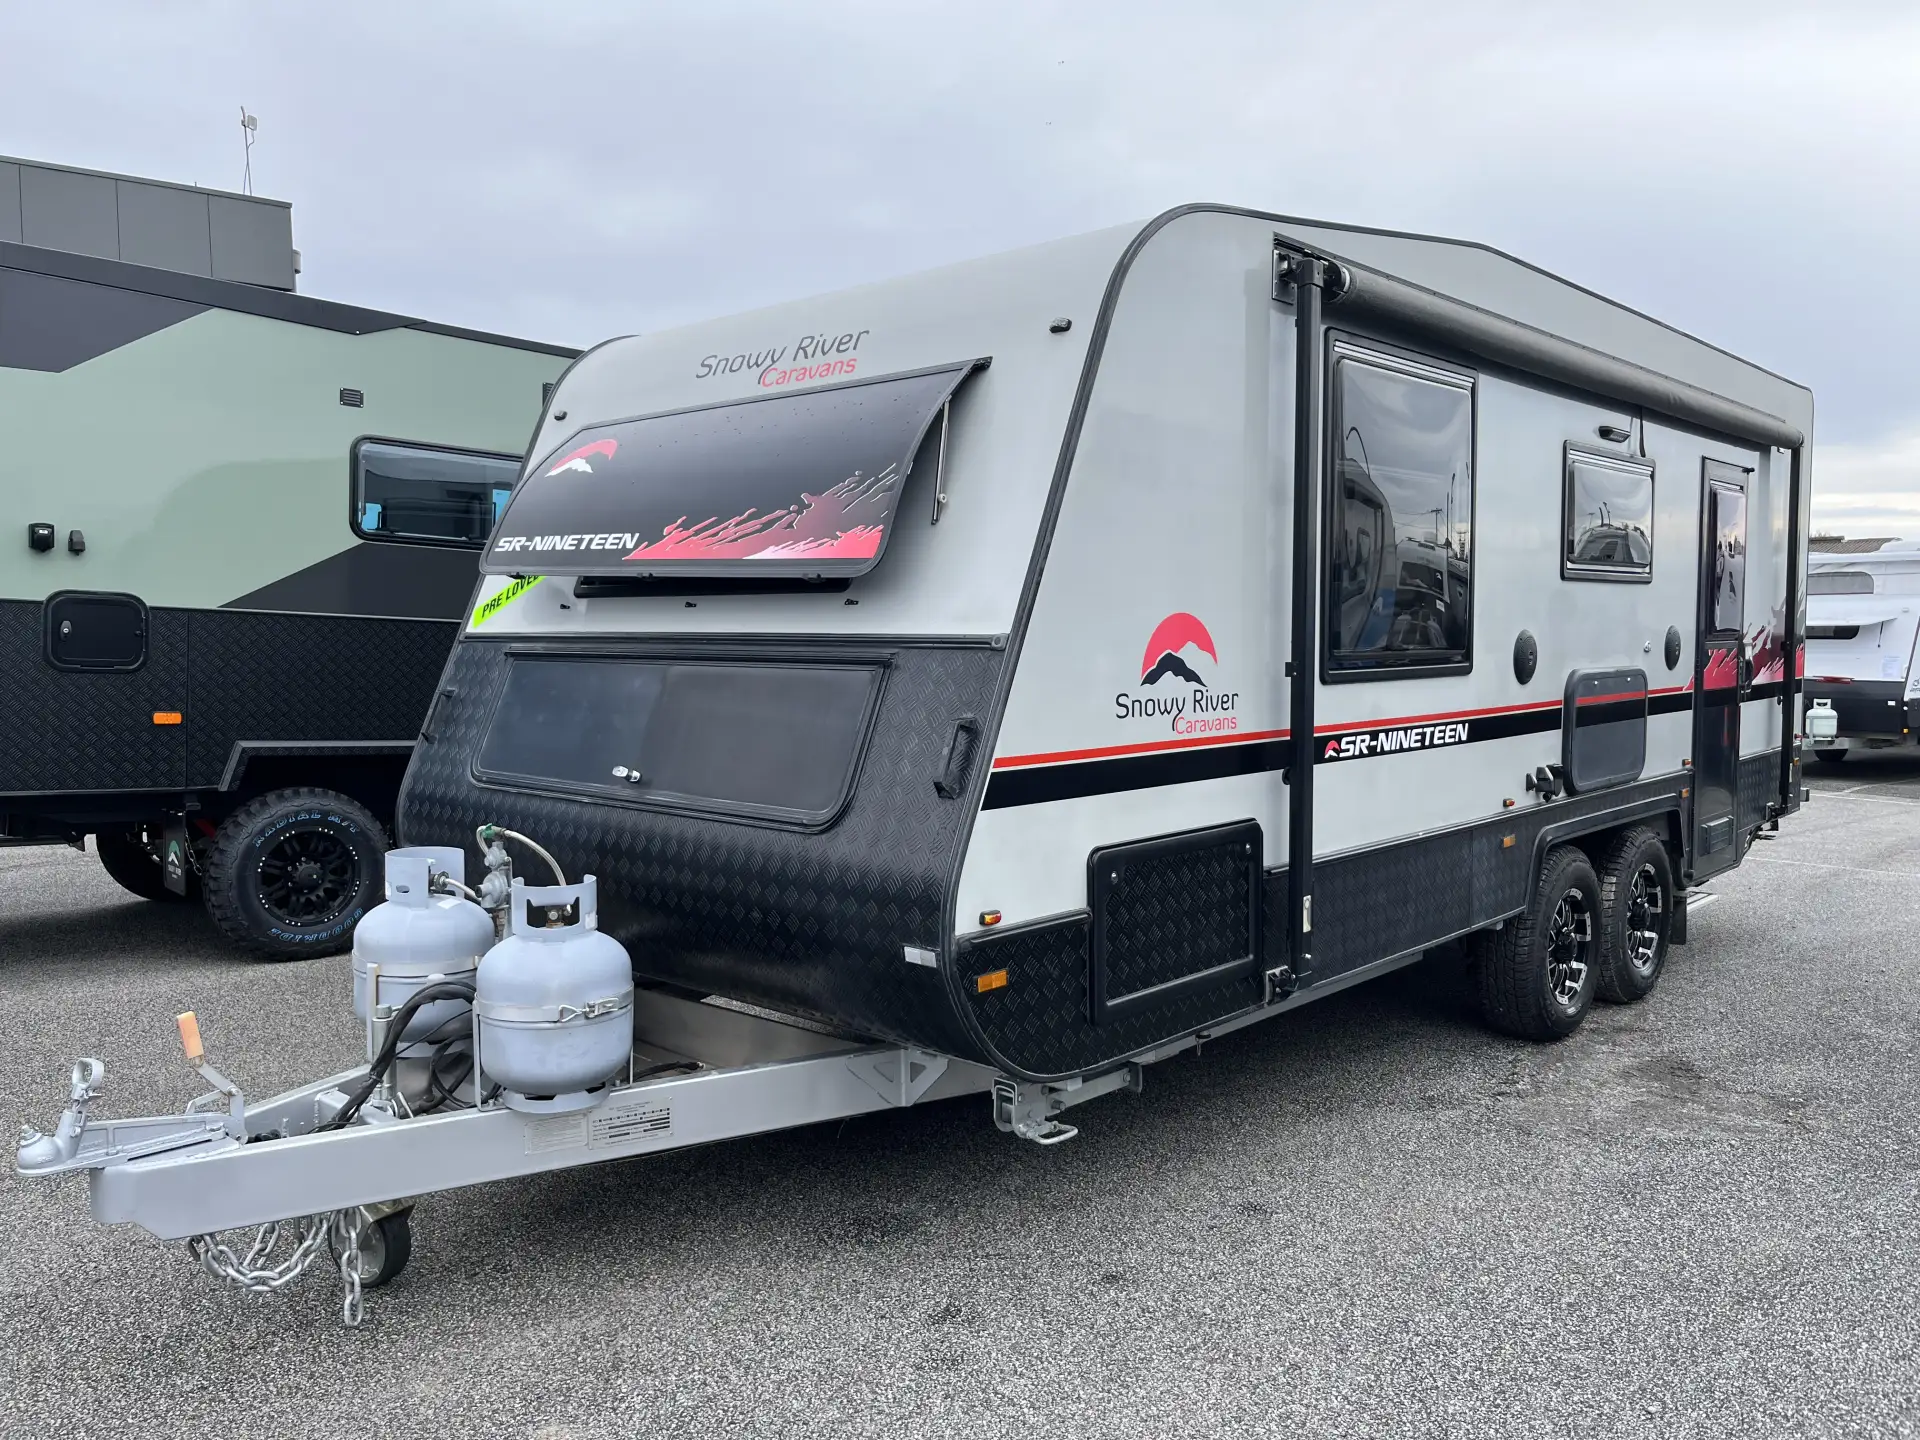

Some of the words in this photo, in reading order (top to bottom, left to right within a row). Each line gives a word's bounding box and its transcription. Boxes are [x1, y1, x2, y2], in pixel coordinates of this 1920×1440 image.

[695, 345, 788, 385] Snowy
[792, 329, 870, 362] River
[761, 358, 857, 387] Caravans
[495, 533, 639, 551] SR-NINETEEN
[481, 593, 503, 618] PRE
[1115, 692, 1186, 731] Snowy
[1193, 689, 1239, 713] River
[1175, 716, 1237, 734] Caravans
[1339, 723, 1469, 757] SR-NINETEEN
